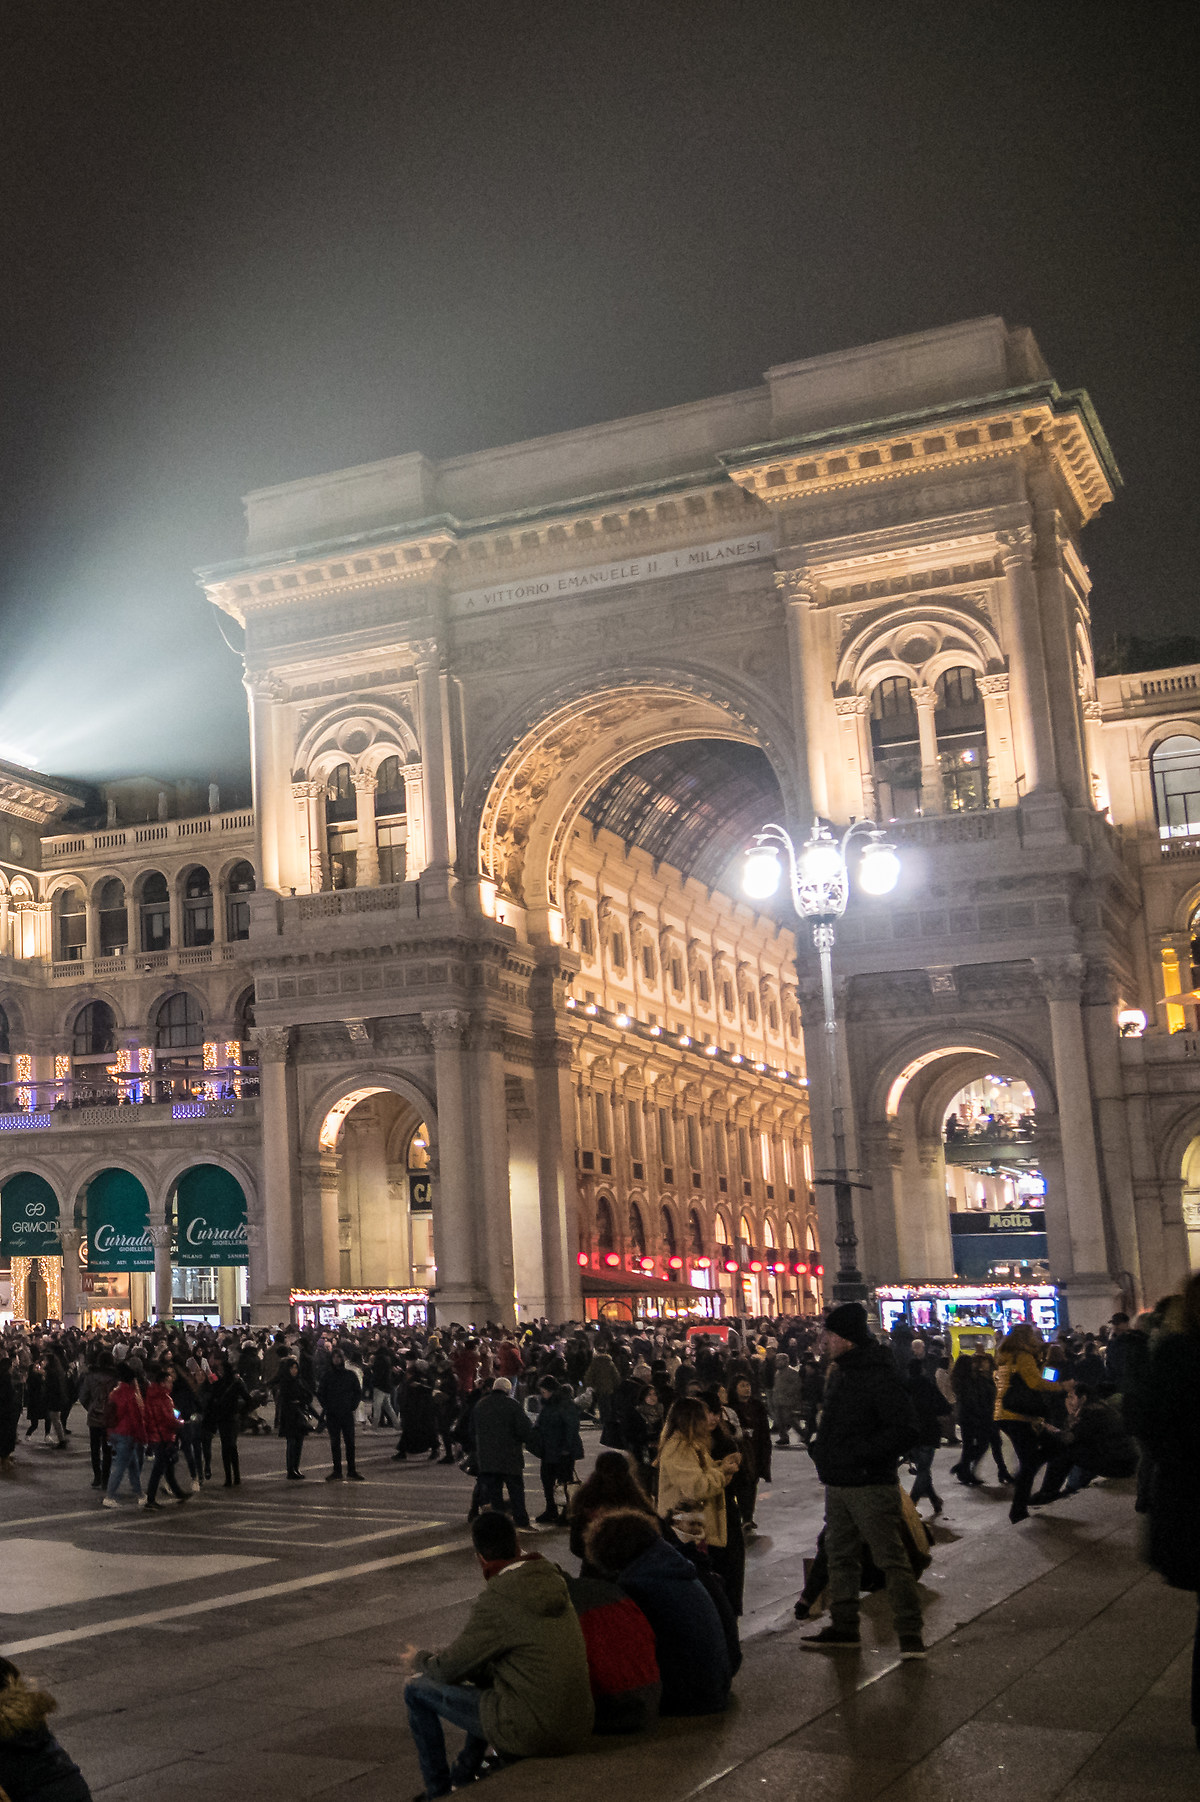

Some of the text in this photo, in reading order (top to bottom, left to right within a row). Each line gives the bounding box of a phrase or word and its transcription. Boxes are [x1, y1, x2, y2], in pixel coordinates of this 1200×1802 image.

[467, 598, 475, 608] A
[484, 583, 549, 603] VITTORIO
[558, 564, 640, 590] EMANUELE
[688, 541, 761, 564] MILANESI
[989, 1213, 1033, 1228] Motta
